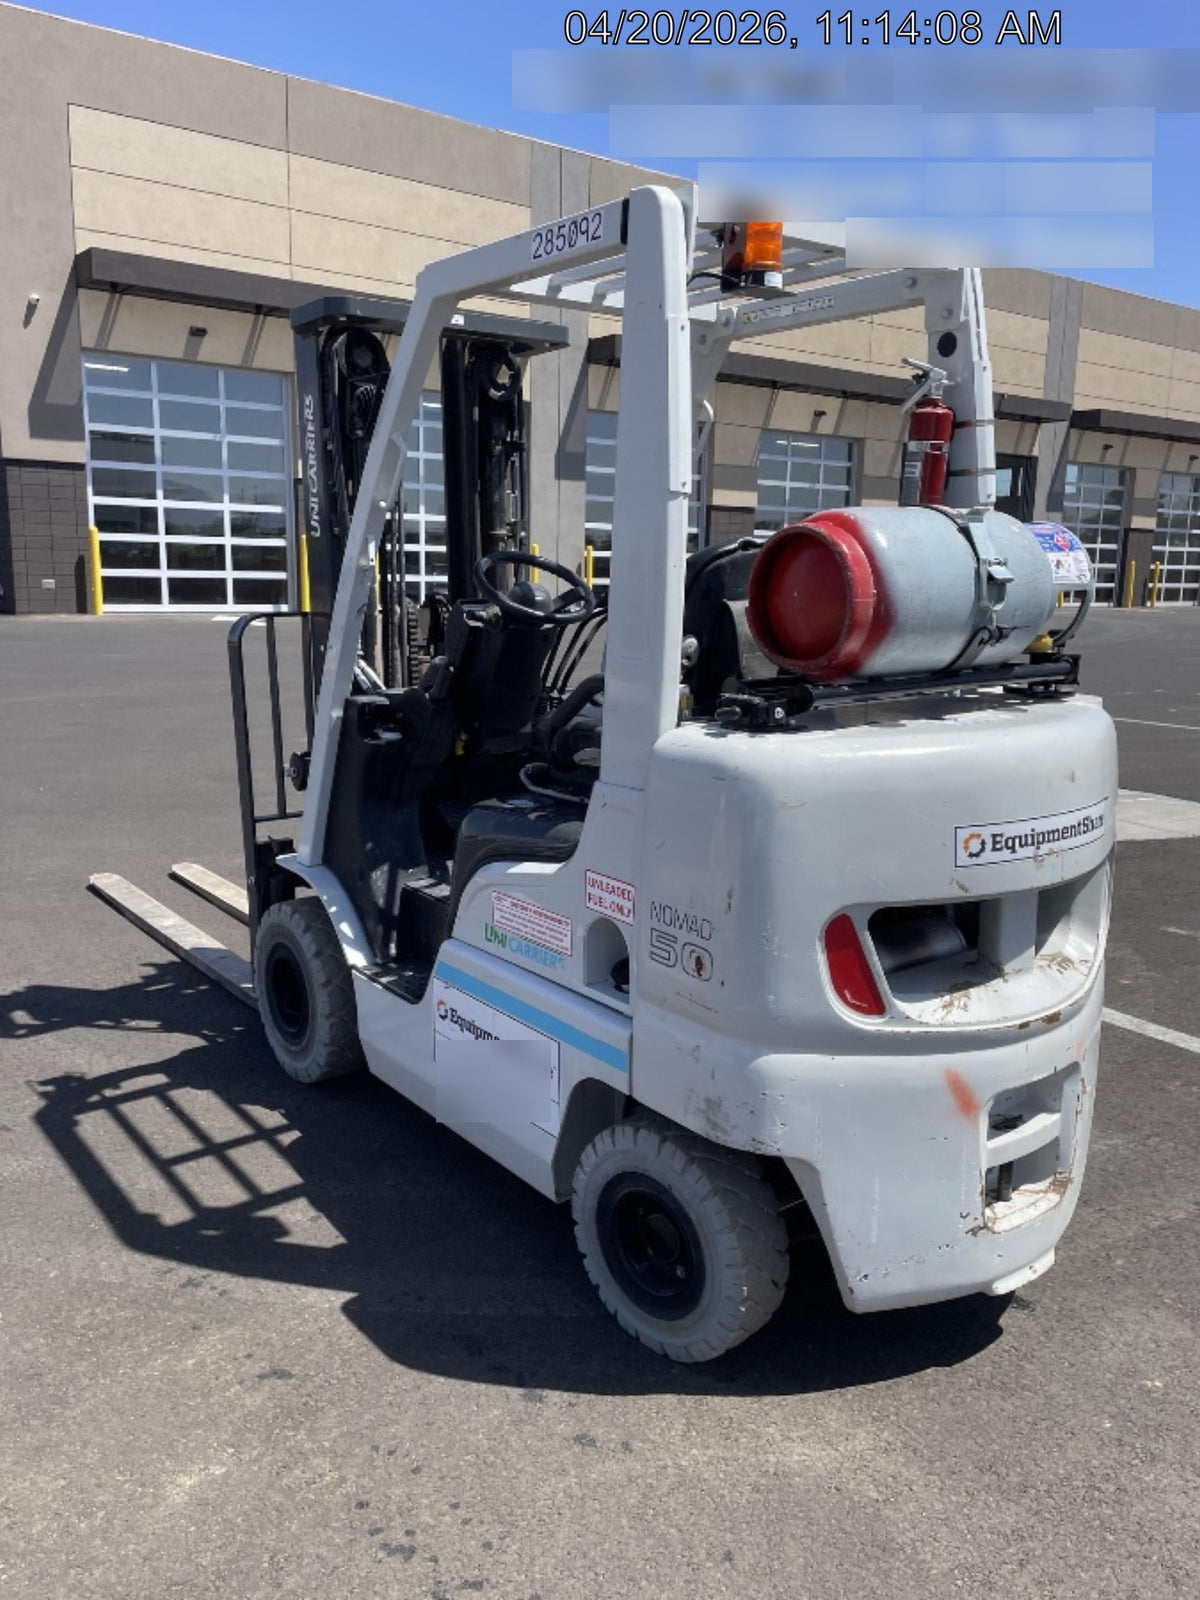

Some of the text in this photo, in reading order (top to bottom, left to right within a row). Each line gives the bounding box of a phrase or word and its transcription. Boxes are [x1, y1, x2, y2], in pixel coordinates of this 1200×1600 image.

[532, 212, 603, 260] 285092
[304, 393, 321, 538] UNICARRIERS
[588, 875, 633, 902] UNLEADED
[588, 891, 632, 918] FUEL ONLY
[650, 900, 713, 941] NOMAD
[649, 927, 714, 983] 50
